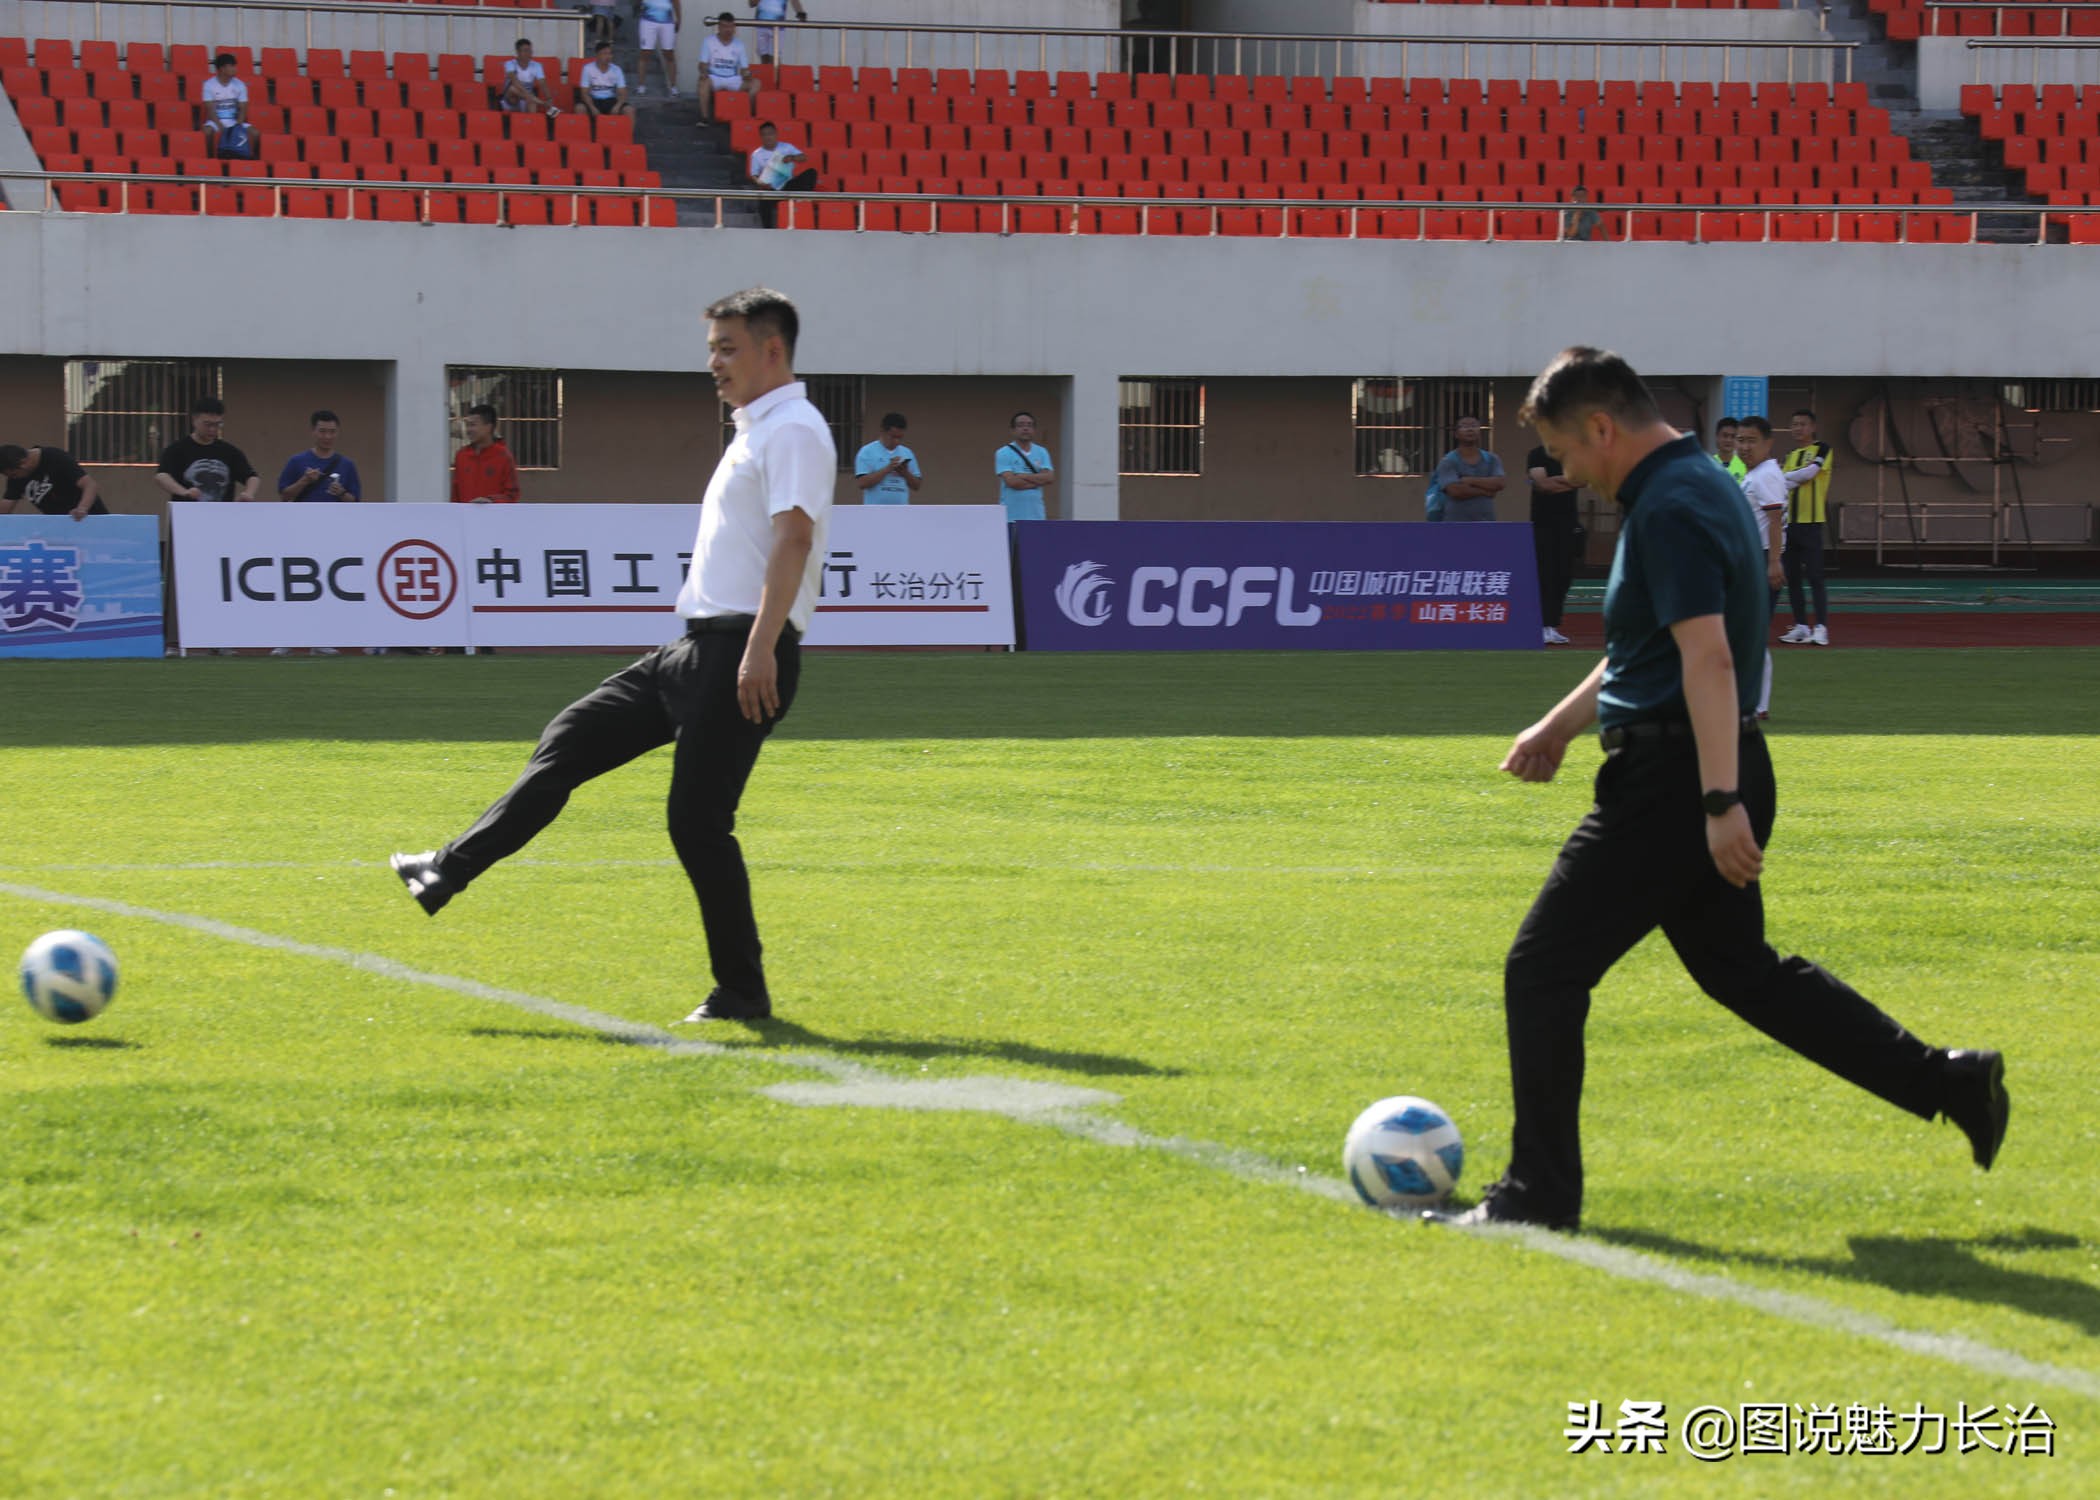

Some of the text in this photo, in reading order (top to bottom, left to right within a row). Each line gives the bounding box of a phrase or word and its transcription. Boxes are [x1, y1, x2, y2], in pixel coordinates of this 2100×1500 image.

[0, 540, 84, 631] 赛
[221, 556, 366, 602] ICBC
[476, 548, 858, 598] 中国工行
[869, 571, 985, 601] 长治分行
[1308, 570, 1512, 596] 中国城市足球联赛
[1127, 566, 1323, 627] CCFL
[1418, 603, 1506, 621] 山西·长治
